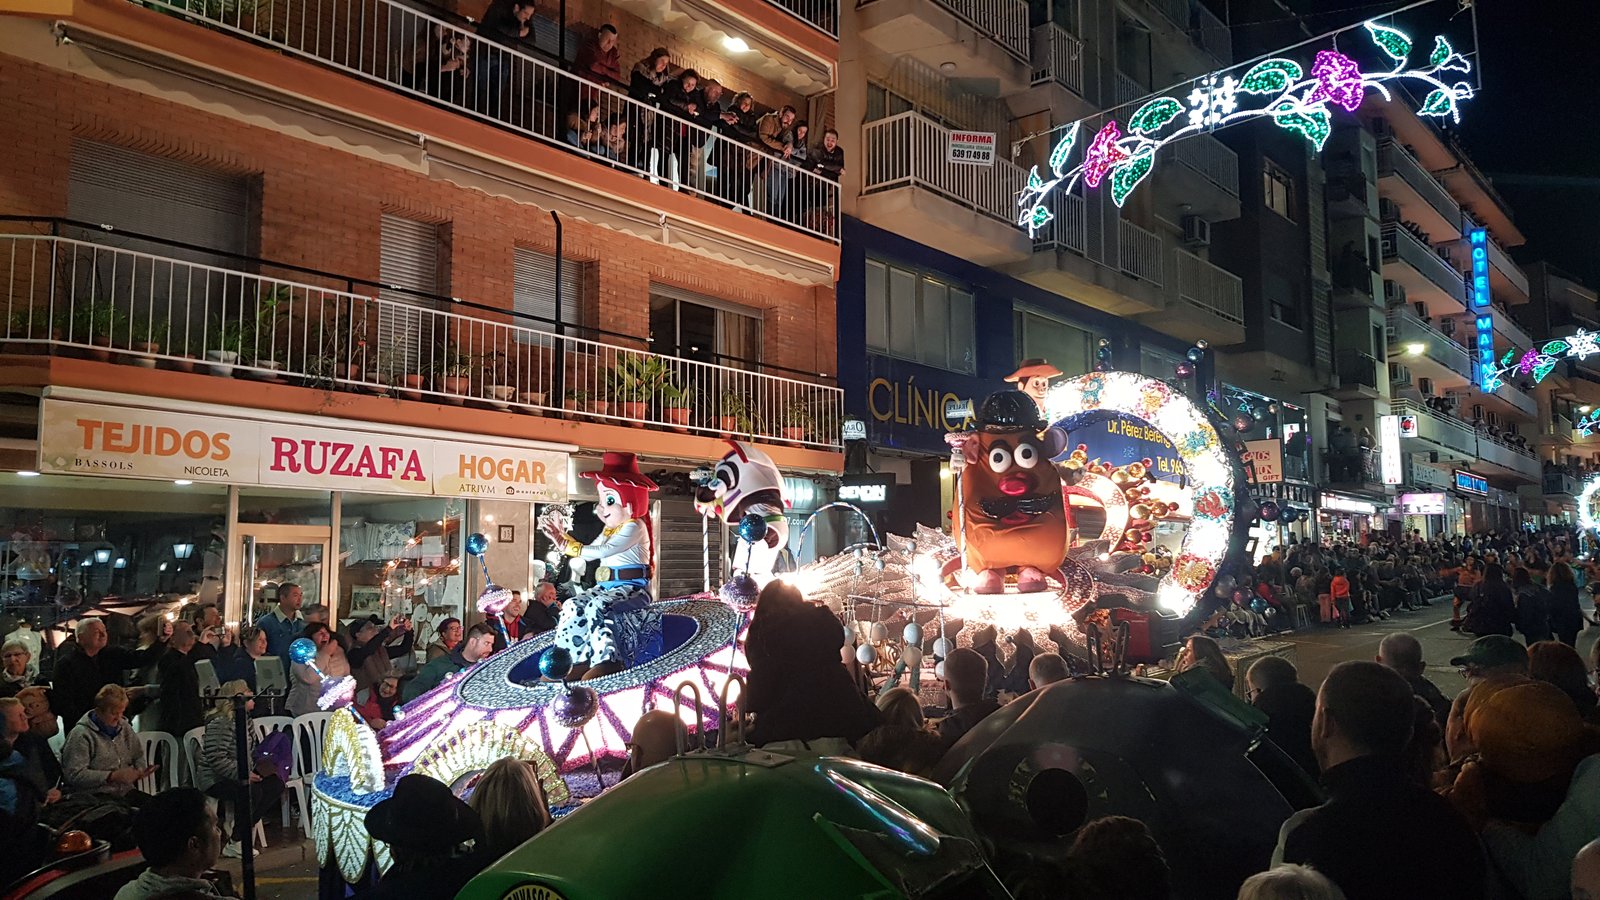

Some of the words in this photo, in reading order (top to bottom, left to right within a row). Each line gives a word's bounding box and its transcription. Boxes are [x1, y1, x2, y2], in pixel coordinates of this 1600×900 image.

[952, 133, 992, 144] INFORMA
[952, 149, 965, 158] 639
[966, 150, 972, 159] 17
[972, 150, 981, 160] 49
[981, 151, 990, 161] 88
[1471, 231, 1488, 304] HOTEL
[868, 375, 977, 433] CLÍNICA
[76, 418, 231, 461] TEJIDOS
[1121, 420, 1144, 440] Pérez
[1144, 427, 1171, 449] Bereng
[75, 458, 133, 470] BASSOLS
[270, 436, 427, 482] RUZAFA
[184, 466, 230, 478] NICOLETA
[459, 454, 547, 485] HOGAR
[459, 483, 496, 494] ATRIVM
[839, 485, 886, 502] SENDIN
[786, 516, 806, 526] 7.com
